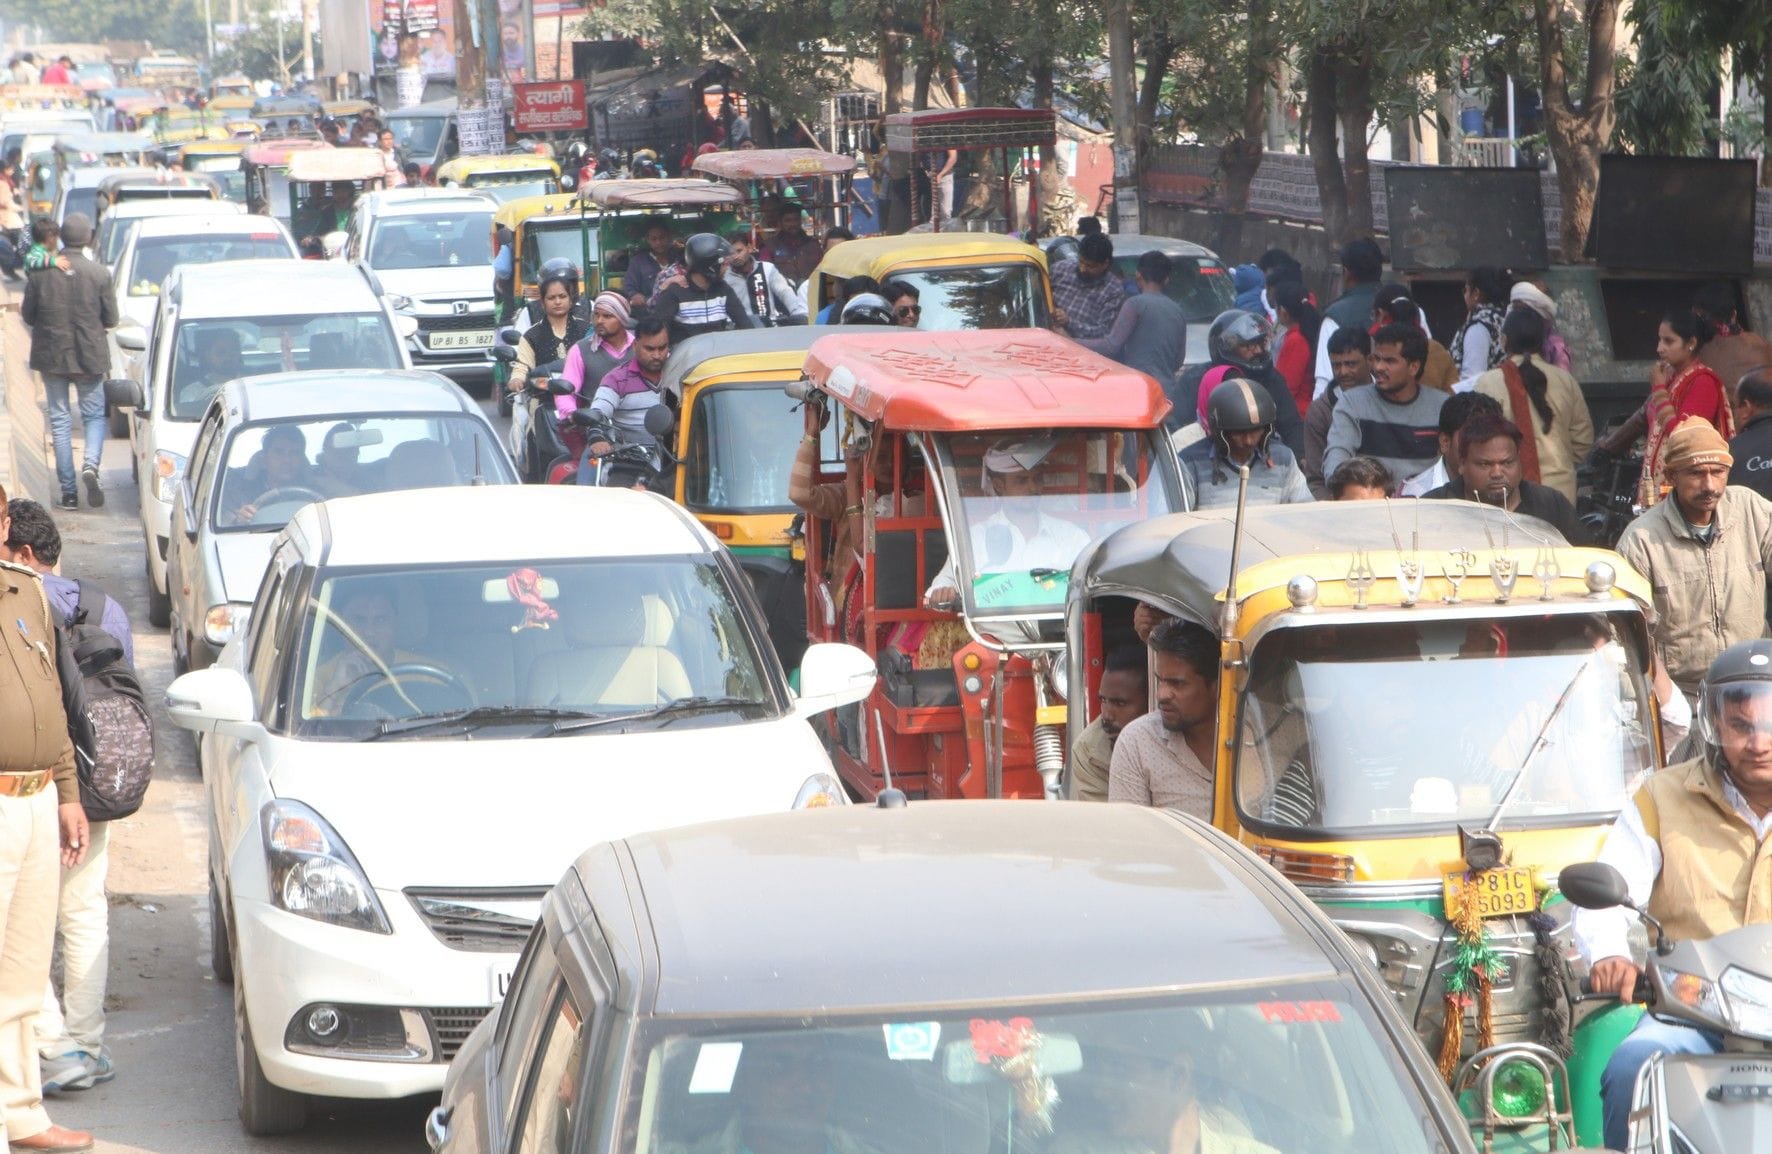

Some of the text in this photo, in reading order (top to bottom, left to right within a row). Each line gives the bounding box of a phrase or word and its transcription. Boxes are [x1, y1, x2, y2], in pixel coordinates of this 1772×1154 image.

[525, 84, 574, 105] त्यागी
[433, 335, 494, 346] UP 81 BS 1827
[982, 578, 1015, 604] VINAY
[1478, 892, 1526, 913] 5093
